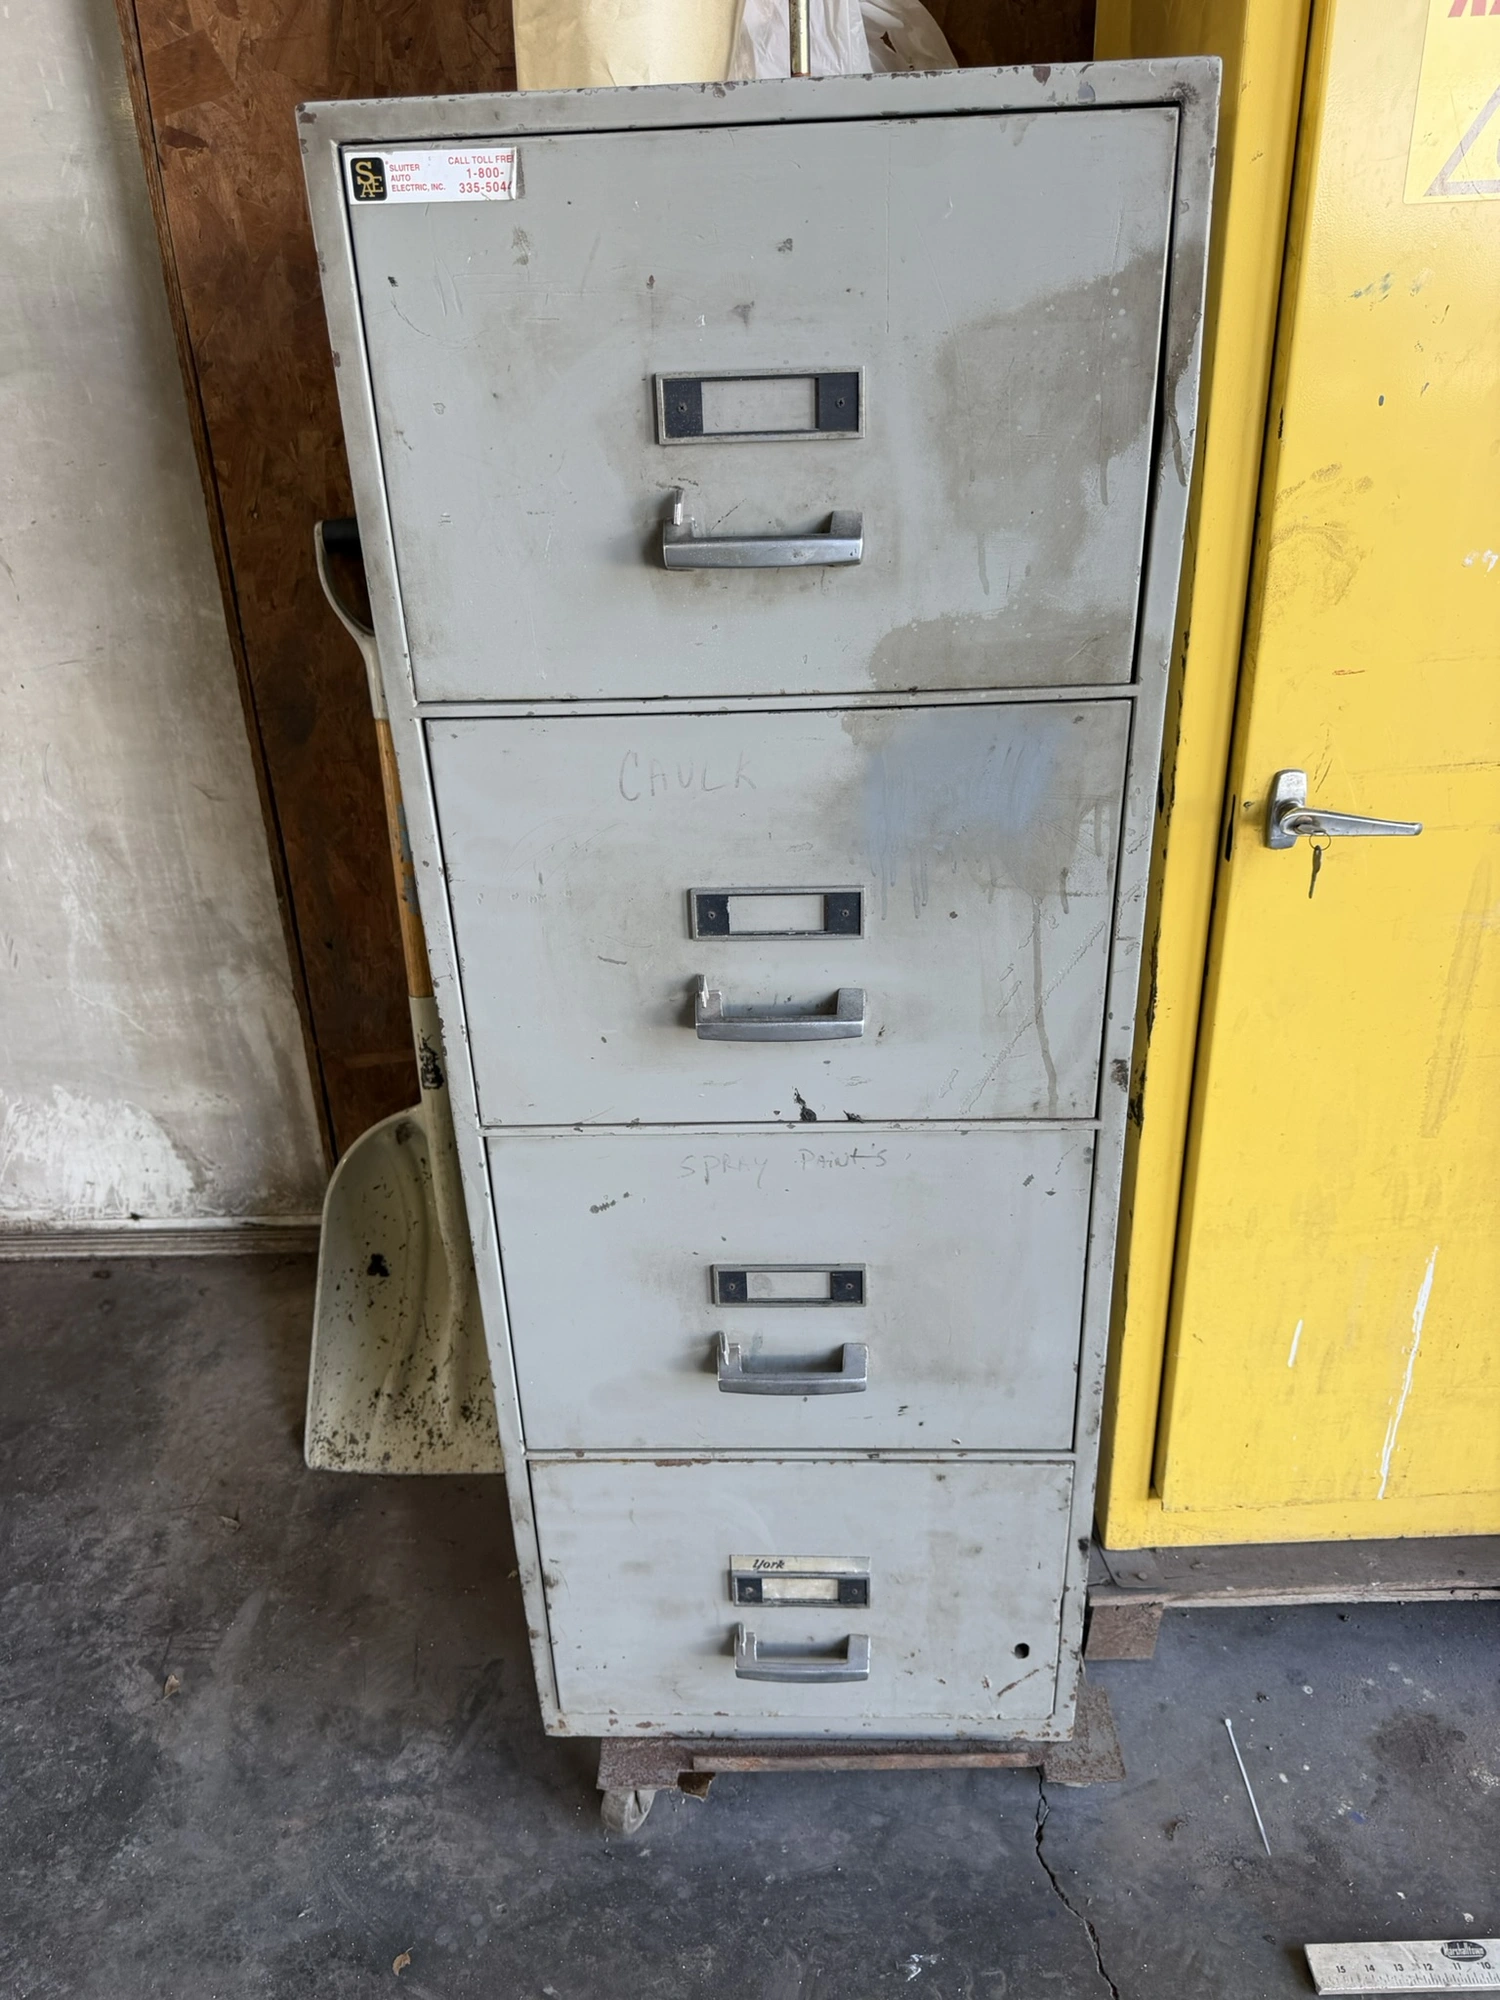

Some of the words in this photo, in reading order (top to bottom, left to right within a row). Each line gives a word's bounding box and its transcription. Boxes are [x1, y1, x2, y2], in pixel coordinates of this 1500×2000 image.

[448, 156, 470, 165] CALL
[472, 155, 494, 164] TOLL
[389, 163, 421, 172] SLUITER
[466, 167, 505, 179] 1-800-
[391, 174, 411, 182] AUTO
[391, 183, 430, 192] ELECTRIC,
[431, 182, 447, 191] INC.
[619, 750, 757, 801] CAULK
[678, 1152, 768, 1189] SPRAY
[1336, 1965, 1346, 1973] 15
[1364, 1964, 1376, 1973] 14
[1393, 1963, 1404, 1972] 13
[1422, 1963, 1434, 1971] 12
[1452, 1962, 1462, 1970] 11
[1480, 1961, 1492, 1970] 10
